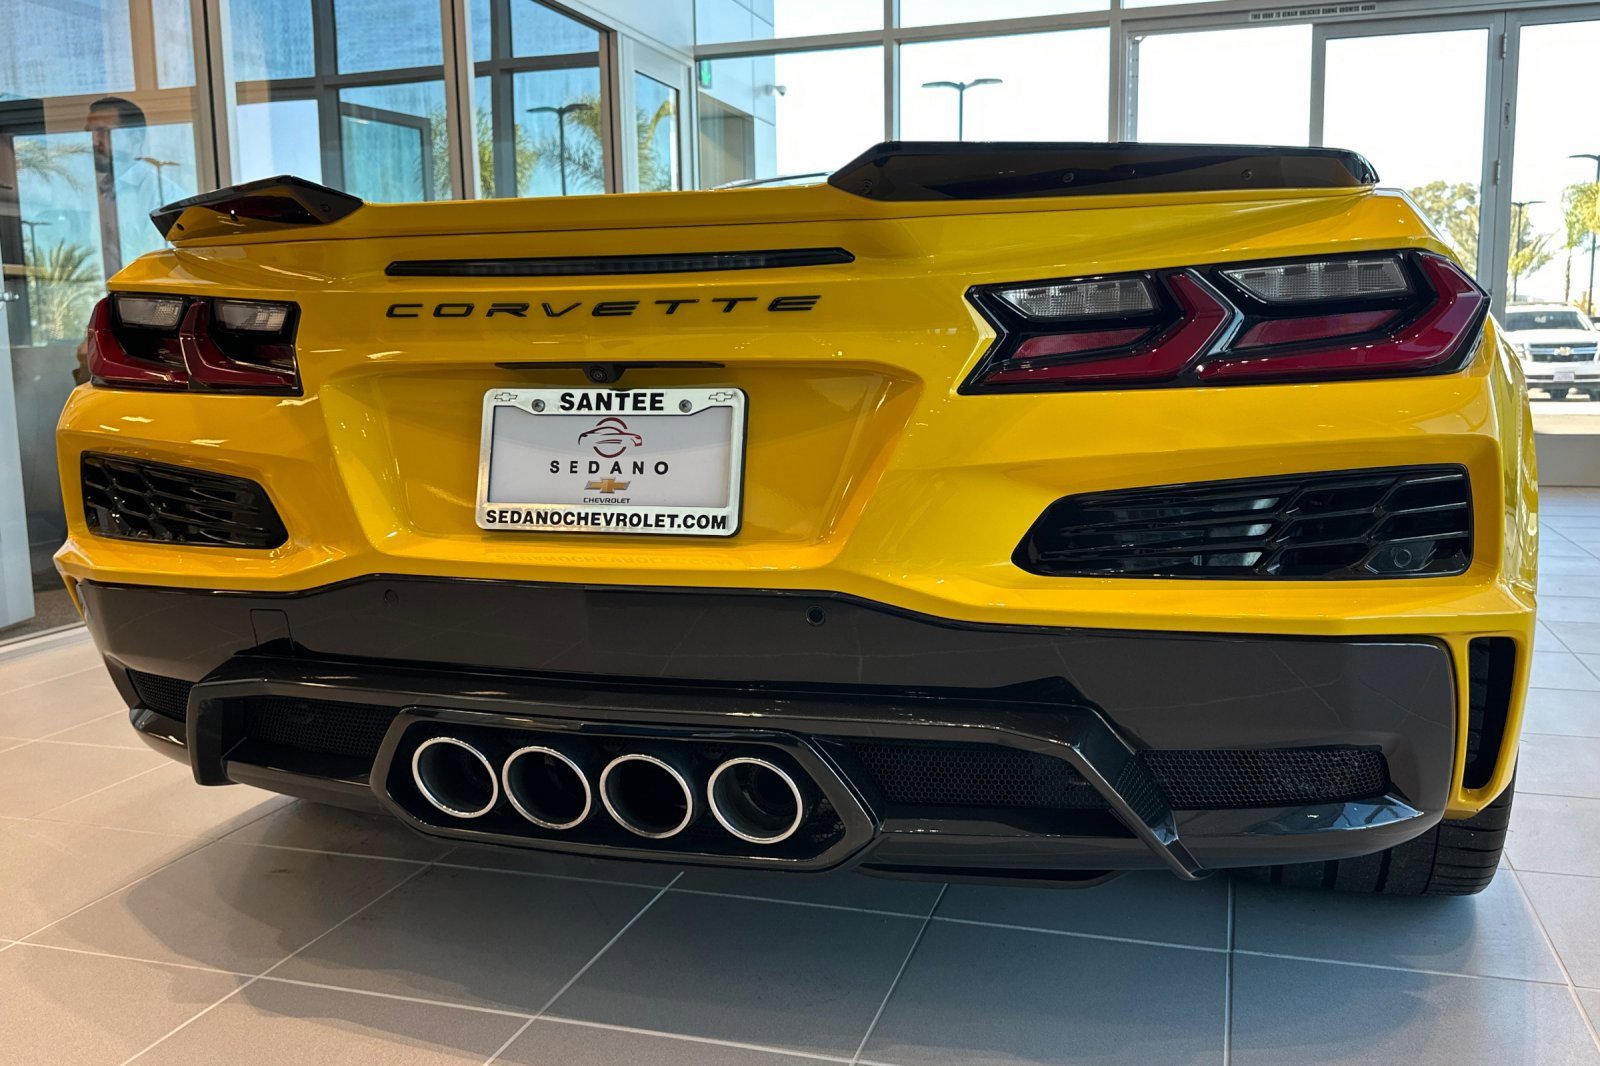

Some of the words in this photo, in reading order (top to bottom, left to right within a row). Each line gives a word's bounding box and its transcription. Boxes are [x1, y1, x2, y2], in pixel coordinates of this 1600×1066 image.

[385, 295, 822, 318] CORVETTE
[559, 392, 665, 411] SANTEE
[549, 460, 669, 475] SEDANO
[485, 510, 727, 529] SEDANOCHEVROLET.COM
